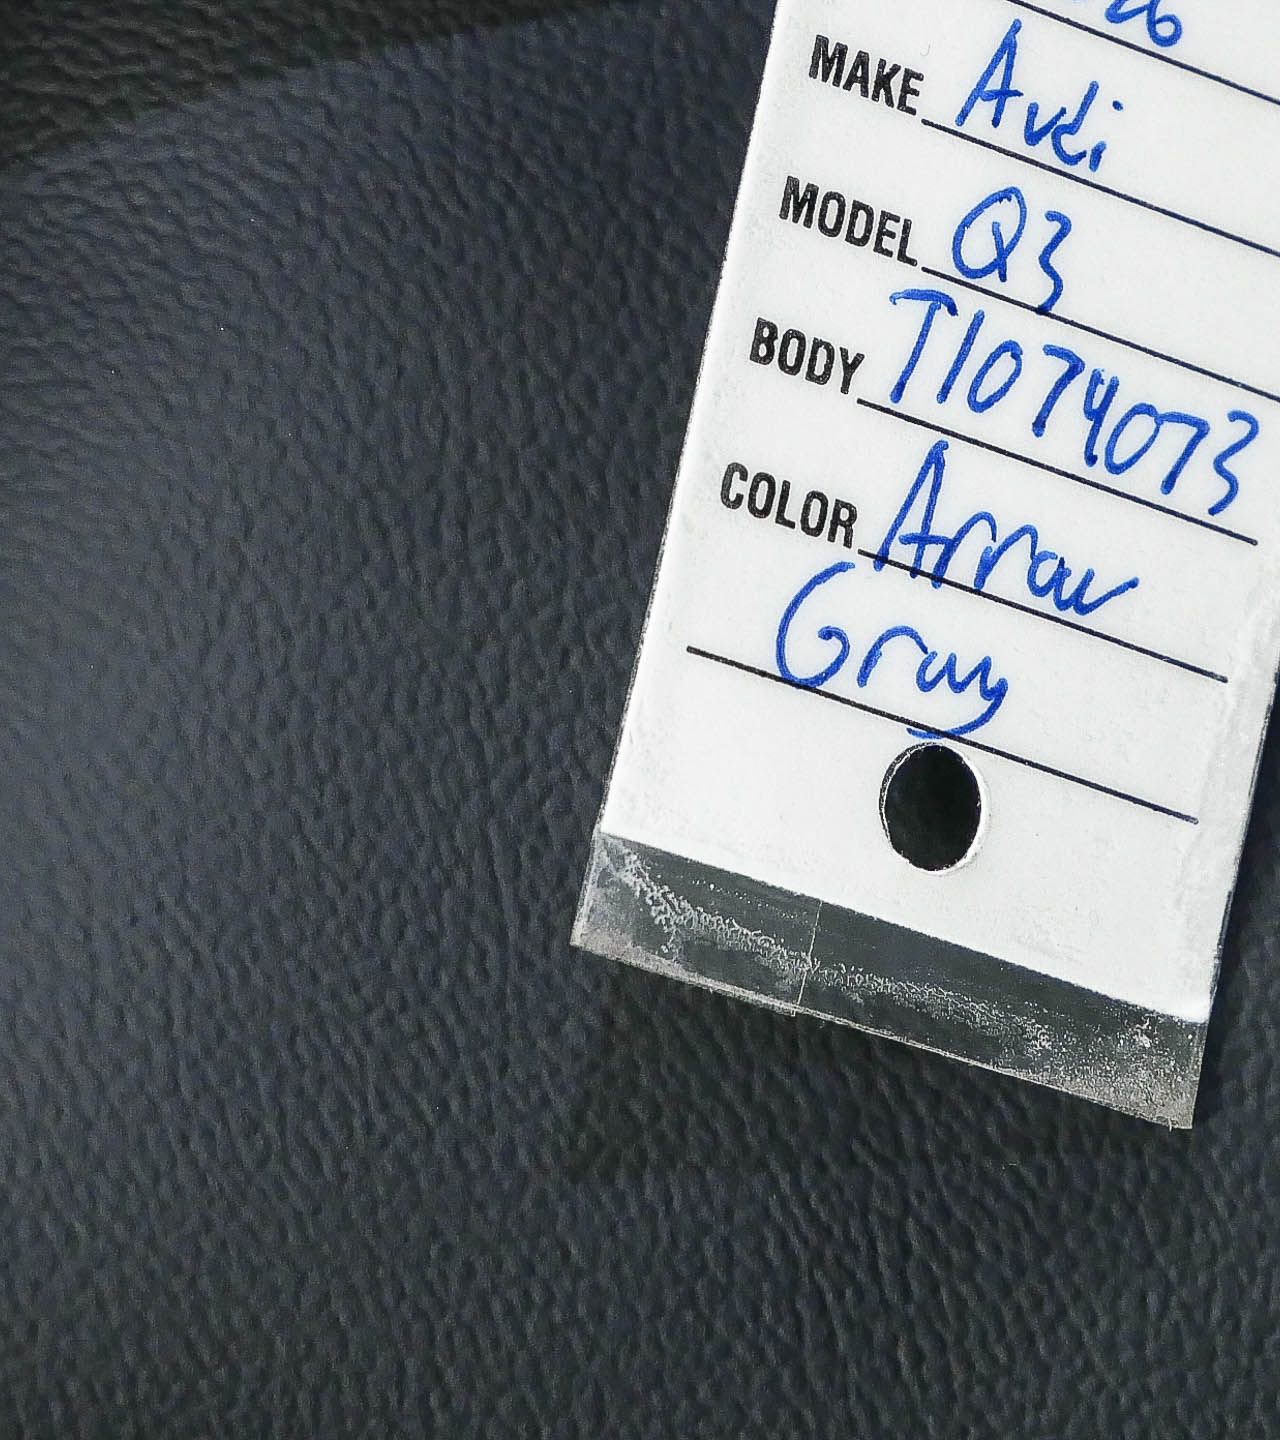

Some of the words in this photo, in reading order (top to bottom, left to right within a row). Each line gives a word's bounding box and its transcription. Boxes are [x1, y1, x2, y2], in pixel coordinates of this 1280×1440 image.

[808, 34, 924, 116] MAKE
[954, 19, 1123, 173] Audi
[778, 176, 918, 267] MODEL
[951, 186, 1072, 314] Q3
[750, 317, 864, 396] BODY
[889, 289, 1260, 516] T1074073
[719, 462, 858, 549] COLOR
[775, 561, 1009, 739] Gray
